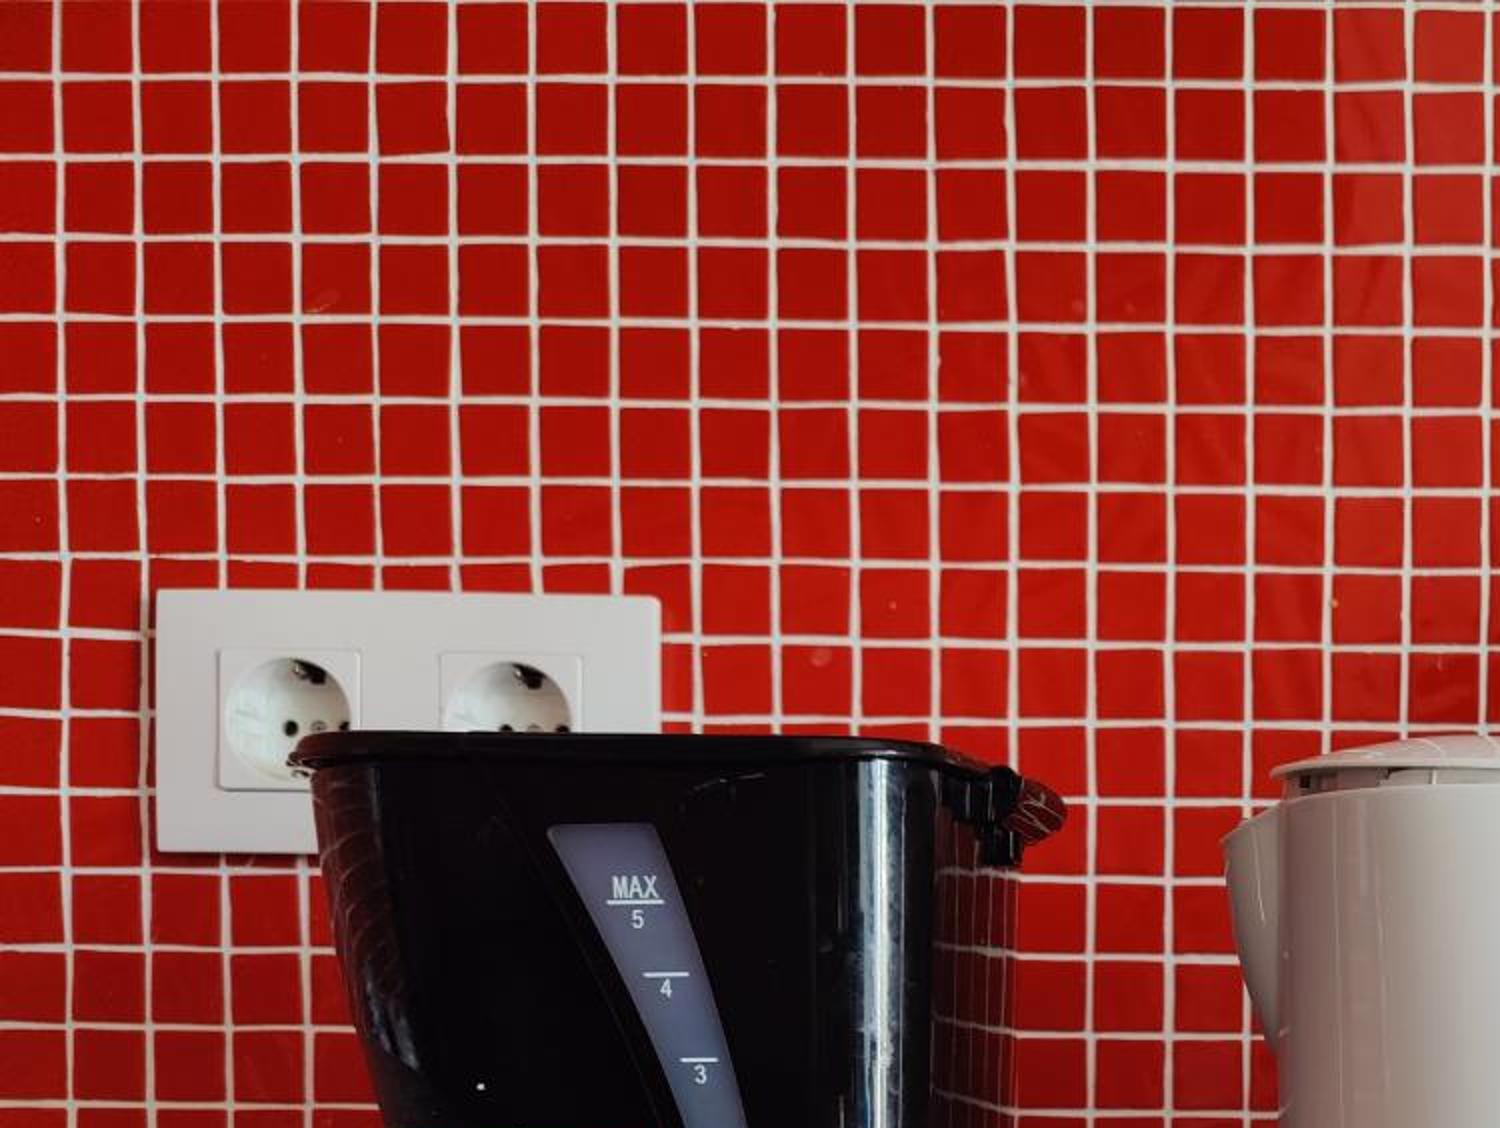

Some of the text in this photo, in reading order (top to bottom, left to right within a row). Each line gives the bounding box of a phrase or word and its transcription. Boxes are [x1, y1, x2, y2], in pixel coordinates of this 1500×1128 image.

[612, 876, 659, 899] MAX
[632, 910, 645, 929] 5
[660, 979, 673, 997] 4
[694, 1065, 707, 1084] 3
